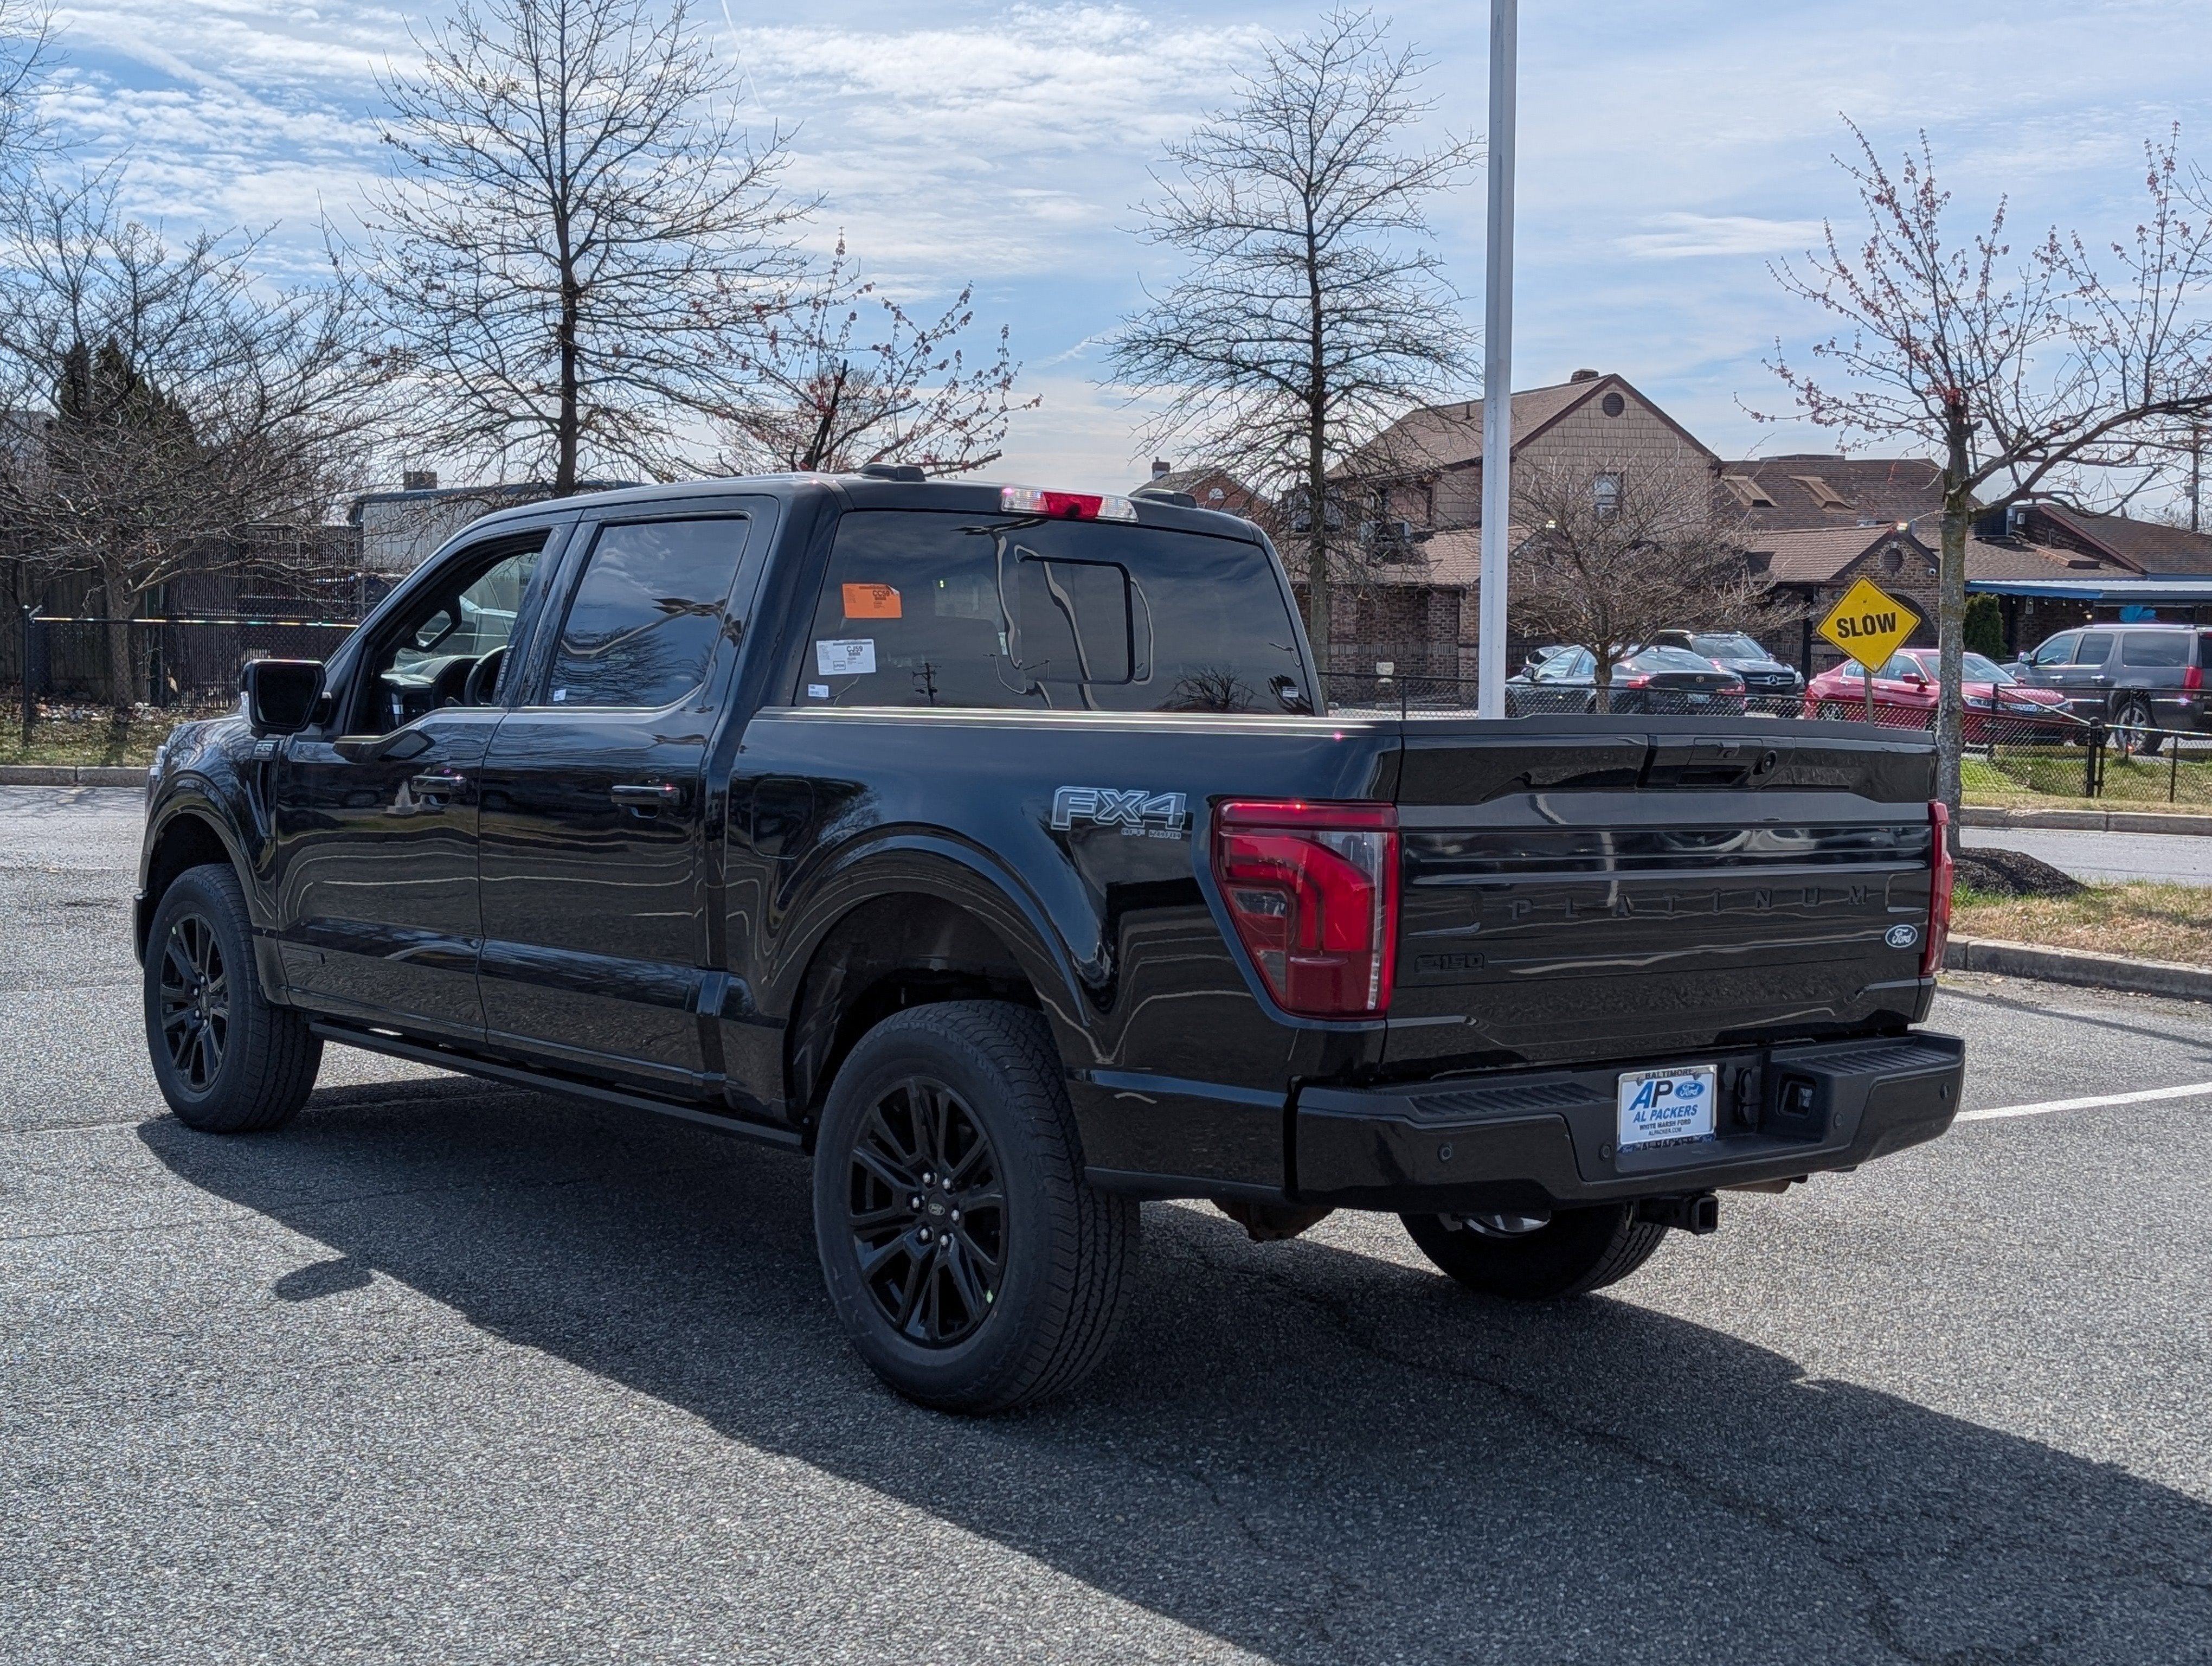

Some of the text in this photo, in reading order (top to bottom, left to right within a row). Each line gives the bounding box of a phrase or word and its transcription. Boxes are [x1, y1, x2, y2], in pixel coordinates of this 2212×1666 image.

[1836, 612, 1896, 639] SLOW
[1051, 786, 1186, 830] FX4
[1512, 885, 1867, 921] PLATINUM
[1891, 928, 1913, 944] Ford
[1645, 1068, 1693, 1079] BALTIMORE
[1628, 1080, 1700, 1110] AP Ford
[1633, 1104, 1698, 1123] AL PACKERS
[1639, 1123, 1656, 1131] WHITE
